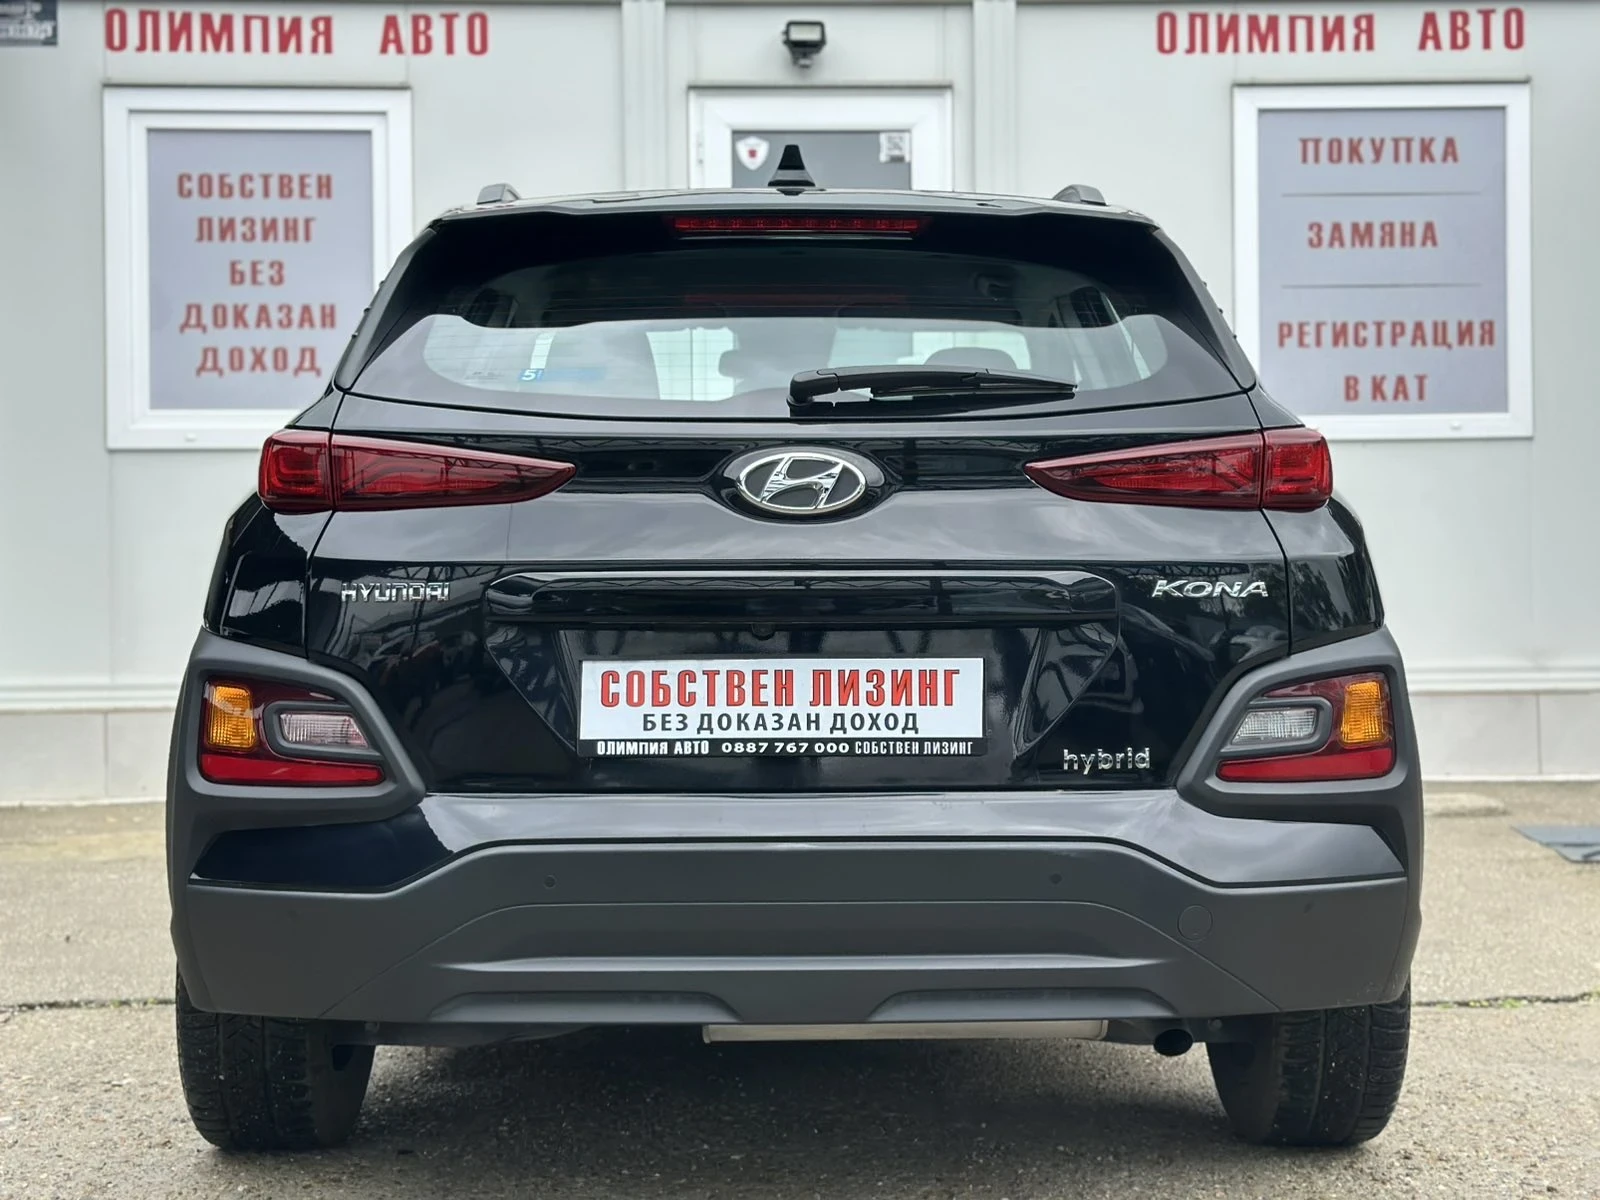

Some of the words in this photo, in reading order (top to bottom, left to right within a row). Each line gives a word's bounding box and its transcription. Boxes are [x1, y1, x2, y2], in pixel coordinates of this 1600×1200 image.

[104, 8, 334, 55] ОЛИМПИЯ
[379, 12, 490, 56] АВТО
[1156, 11, 1376, 55] ОЛИМПИЯ
[1418, 8, 1526, 51] АВТО
[1299, 136, 1459, 165] ПОКУПКА
[177, 173, 334, 200] СОБСТВЕН
[195, 217, 317, 243] ЛИЗИНГ
[1308, 221, 1438, 249] ЗАМЯНА
[229, 260, 286, 287] БЕЗ
[179, 303, 337, 333] ДОКАЗАН
[1277, 320, 1496, 351] РЕГИСТРАЦИЯ
[196, 347, 322, 377] ДОХОД
[1344, 376, 1359, 403] В
[1371, 374, 1429, 402] КАТ
[341, 582, 450, 602] HYUNDAI
[1151, 579, 1269, 598] KONA
[600, 669, 795, 708] СОБСТВЕН
[809, 669, 961, 707] ЛИЗИНГ
[642, 712, 690, 732] БЕЗ
[697, 712, 821, 735] ДОКАЗАН
[829, 711, 920, 735] ДОХОД
[596, 740, 669, 756] ОЛИМПИЯ
[673, 740, 710, 755] АВТО
[721, 741, 769, 753] 0887
[774, 741, 809, 753] 767
[814, 741, 850, 754] 000
[855, 741, 920, 755] СОБСТВЕН
[923, 741, 974, 755] ЛИЗИНГ
[1063, 747, 1150, 776] hybrid
